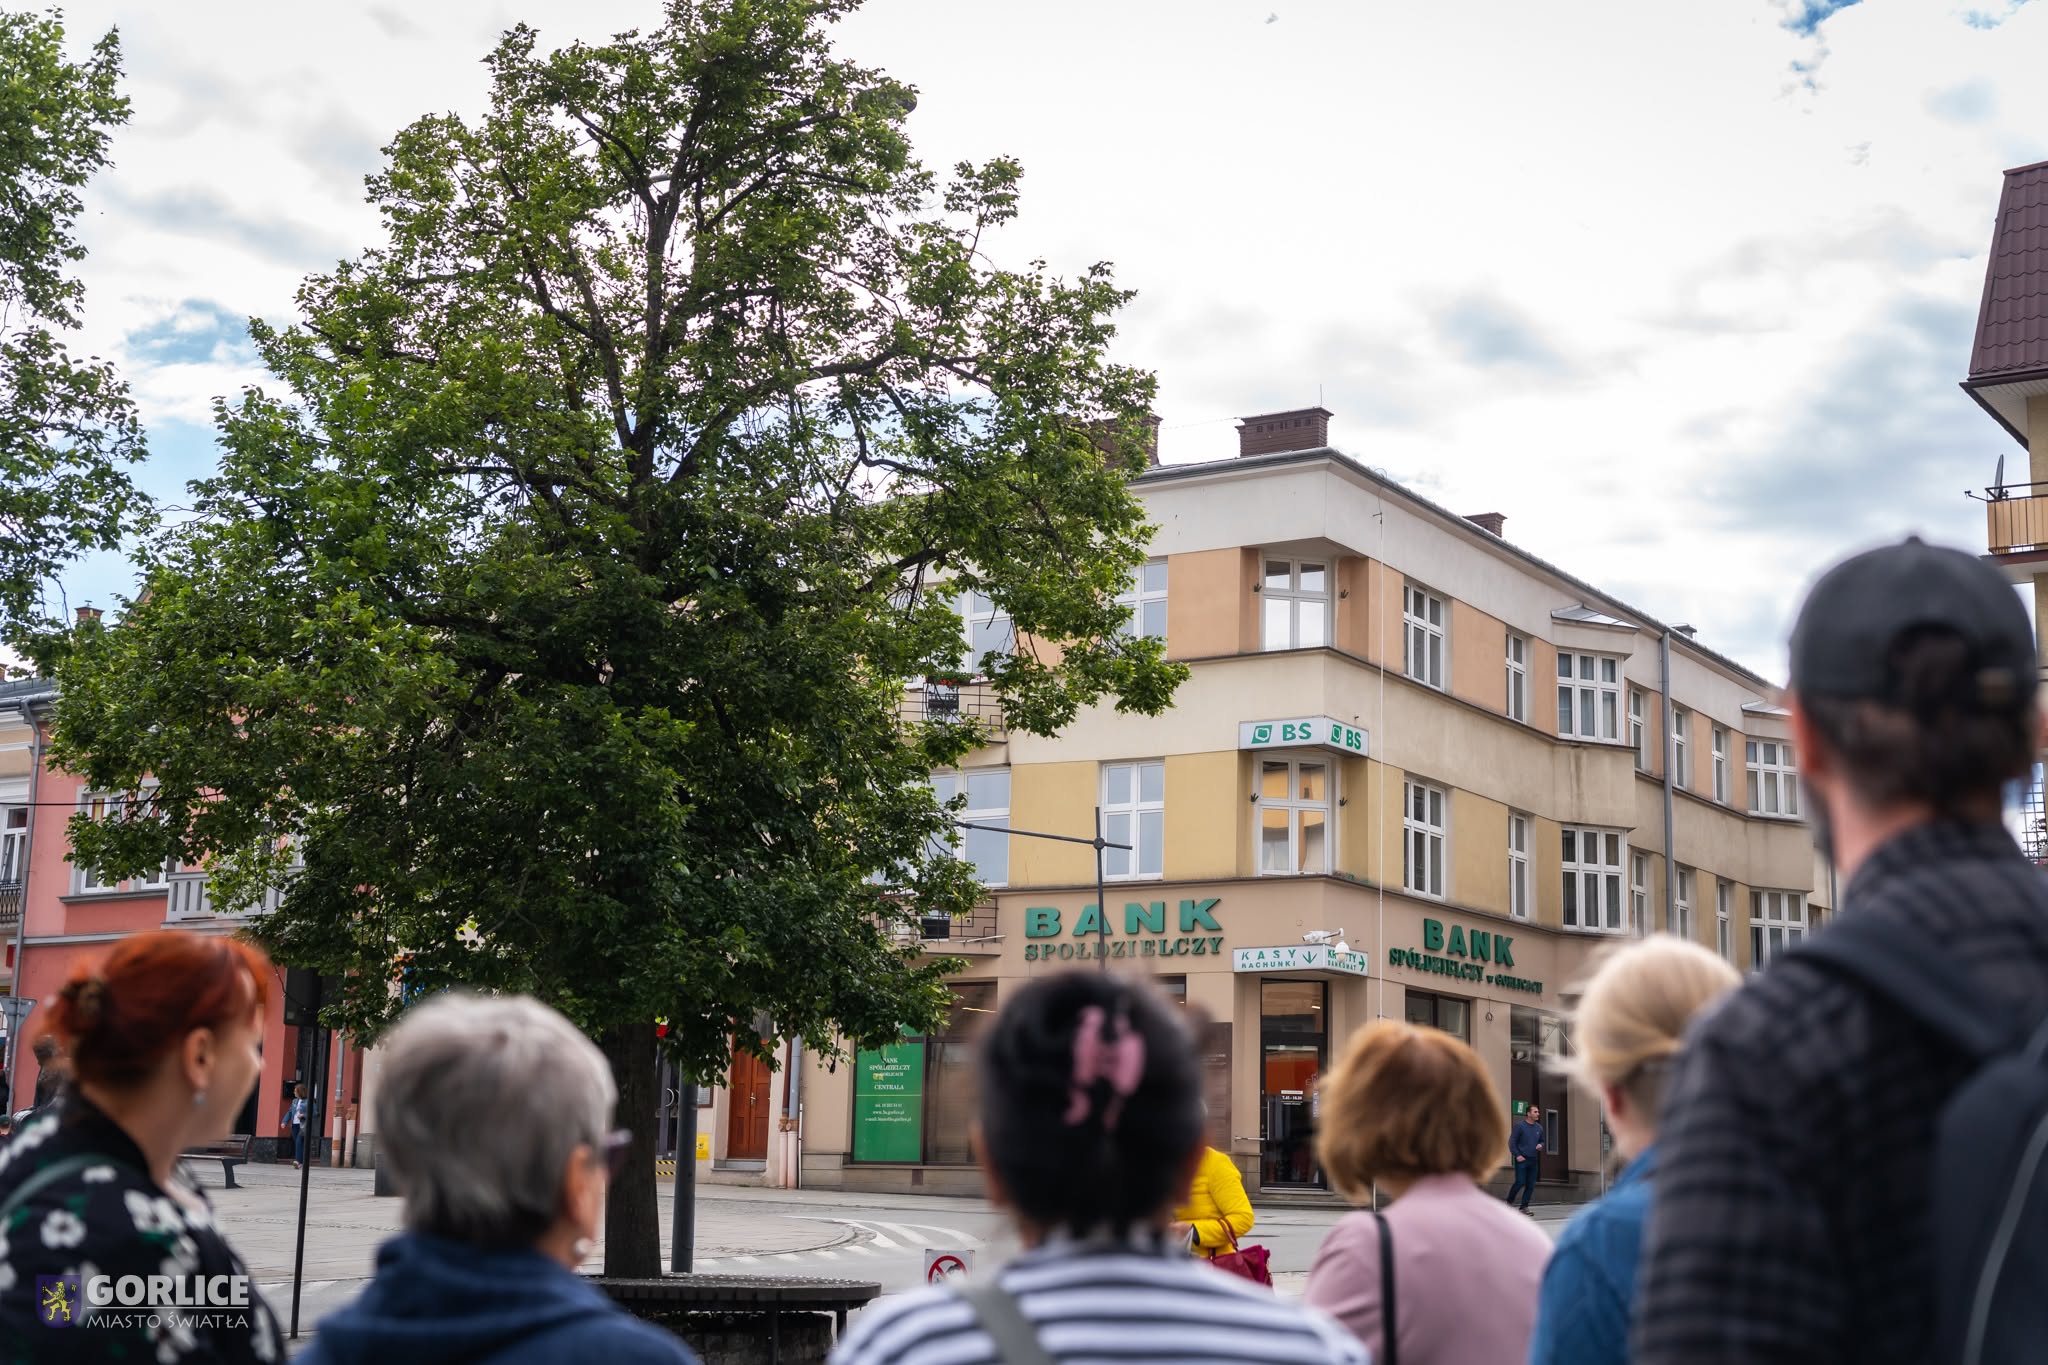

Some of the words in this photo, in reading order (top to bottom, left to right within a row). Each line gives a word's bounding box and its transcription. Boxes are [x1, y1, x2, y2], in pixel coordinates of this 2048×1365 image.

[1282, 722, 1312, 742] BS
[1346, 729, 1362, 750] BS
[1025, 898, 1223, 938] BANK
[1423, 918, 1515, 967] BANK
[1241, 949, 1297, 961] KASY
[1241, 960, 1297, 969] RACHUNKI
[1389, 947, 1485, 982] SPÓŁDZIELCZY
[1327, 959, 1357, 972] BANKOMAT
